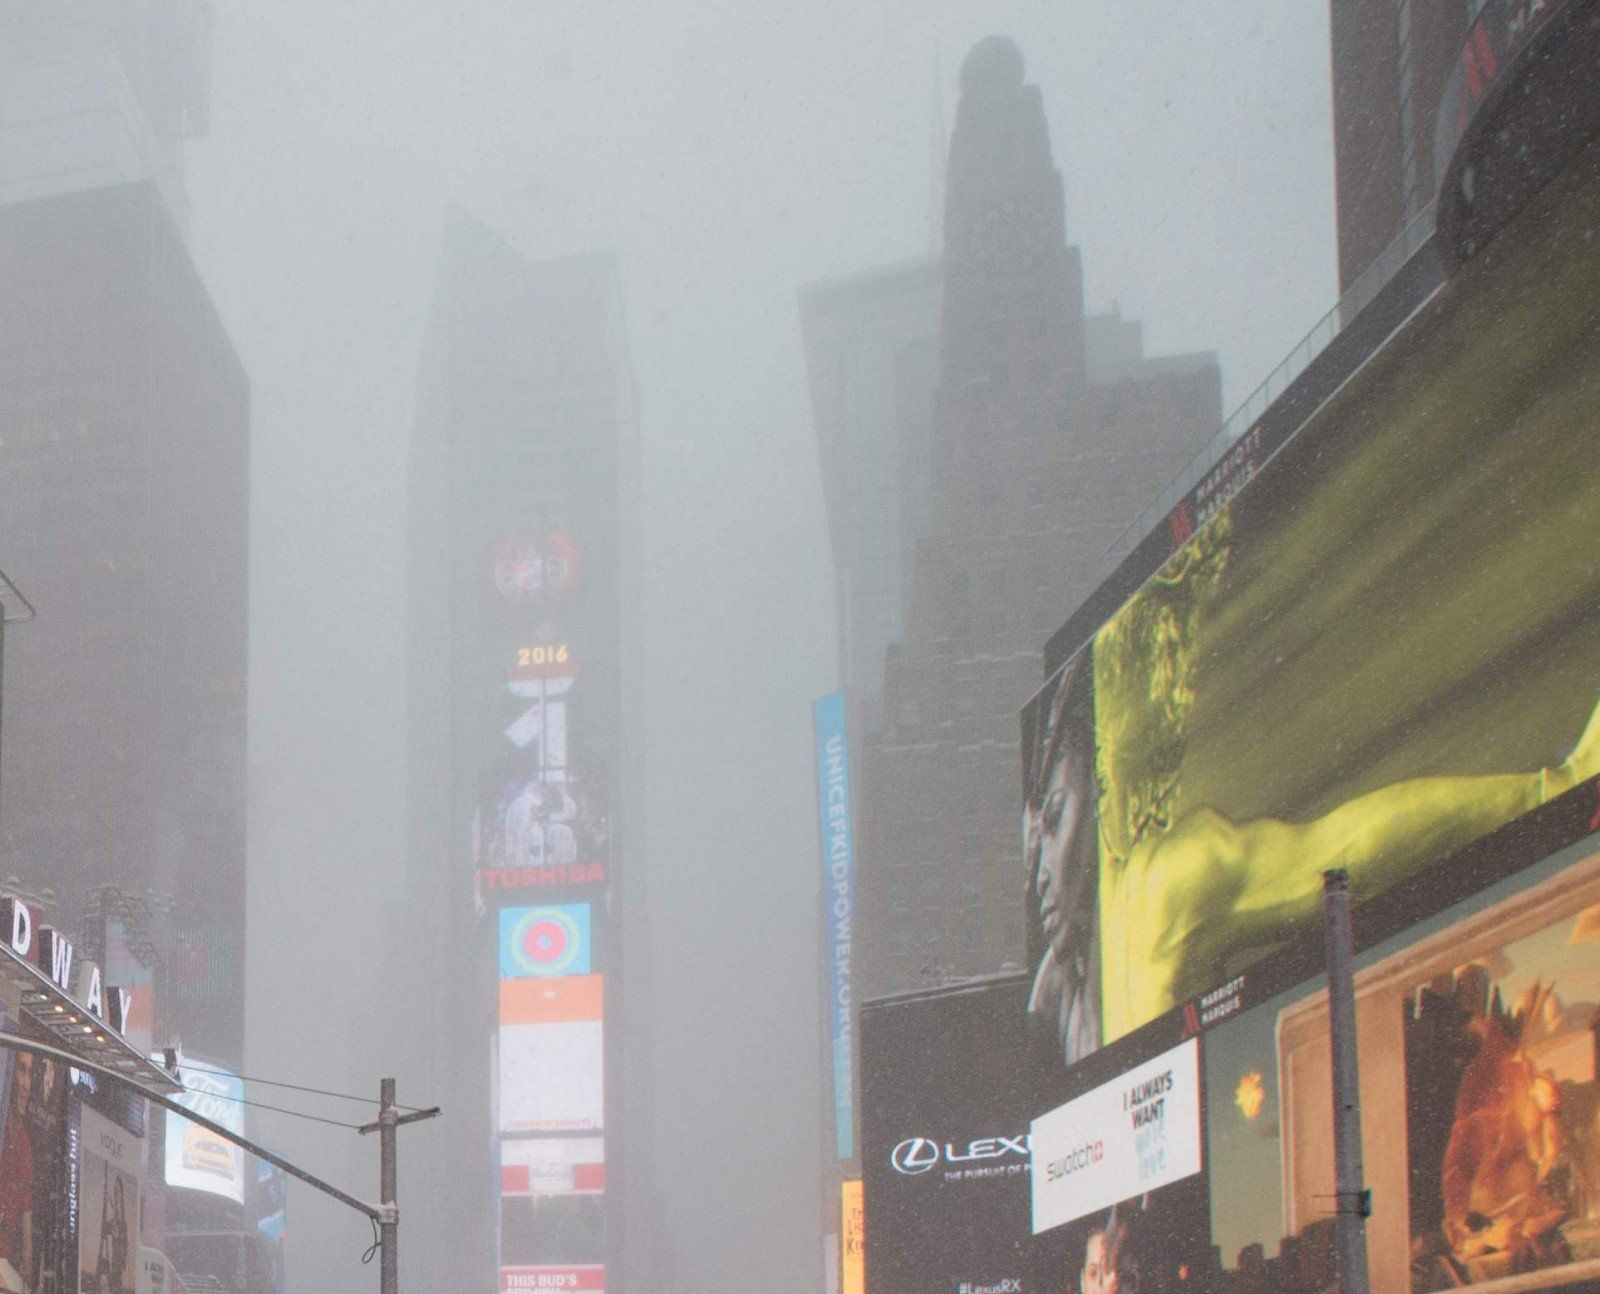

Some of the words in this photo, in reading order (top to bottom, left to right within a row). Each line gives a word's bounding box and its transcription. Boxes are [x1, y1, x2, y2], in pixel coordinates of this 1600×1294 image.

[517, 644, 568, 667] 2016
[485, 862, 604, 890] TOSHIBA
[1130, 1068, 1174, 1107] ALWAYS
[1130, 1097, 1166, 1131] WANT
[946, 1134, 1031, 1161] LEX
[945, 1166, 961, 1180] THE
[964, 1164, 1005, 1179] PURSUIT
[1007, 1163, 1022, 1174] OF
[1045, 1142, 1094, 1183] swatch
[506, 1275, 535, 1288] THIS
[538, 1274, 578, 1287] BUD'S
